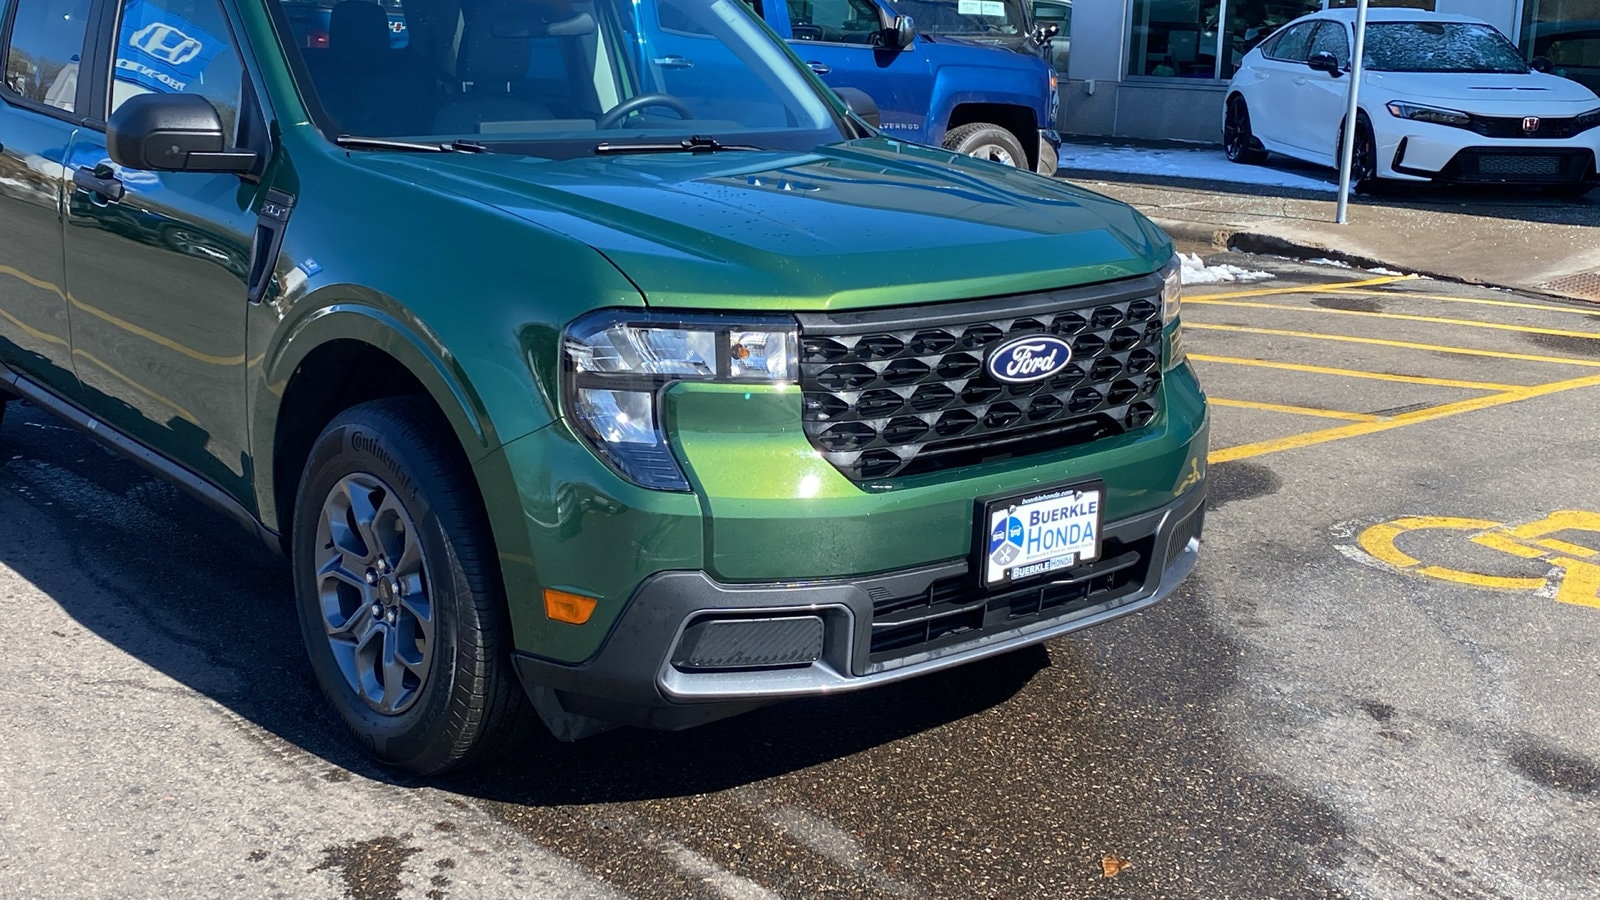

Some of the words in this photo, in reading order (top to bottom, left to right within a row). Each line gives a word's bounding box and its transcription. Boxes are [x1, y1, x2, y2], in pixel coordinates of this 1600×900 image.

[879, 122, 920, 130] LVERADO
[1007, 343, 1058, 376] Ford
[351, 430, 412, 490] Continental
[1029, 501, 1097, 527] BUERKLE
[1027, 521, 1095, 555] HONDA
[1013, 560, 1050, 578] BUERKLE
